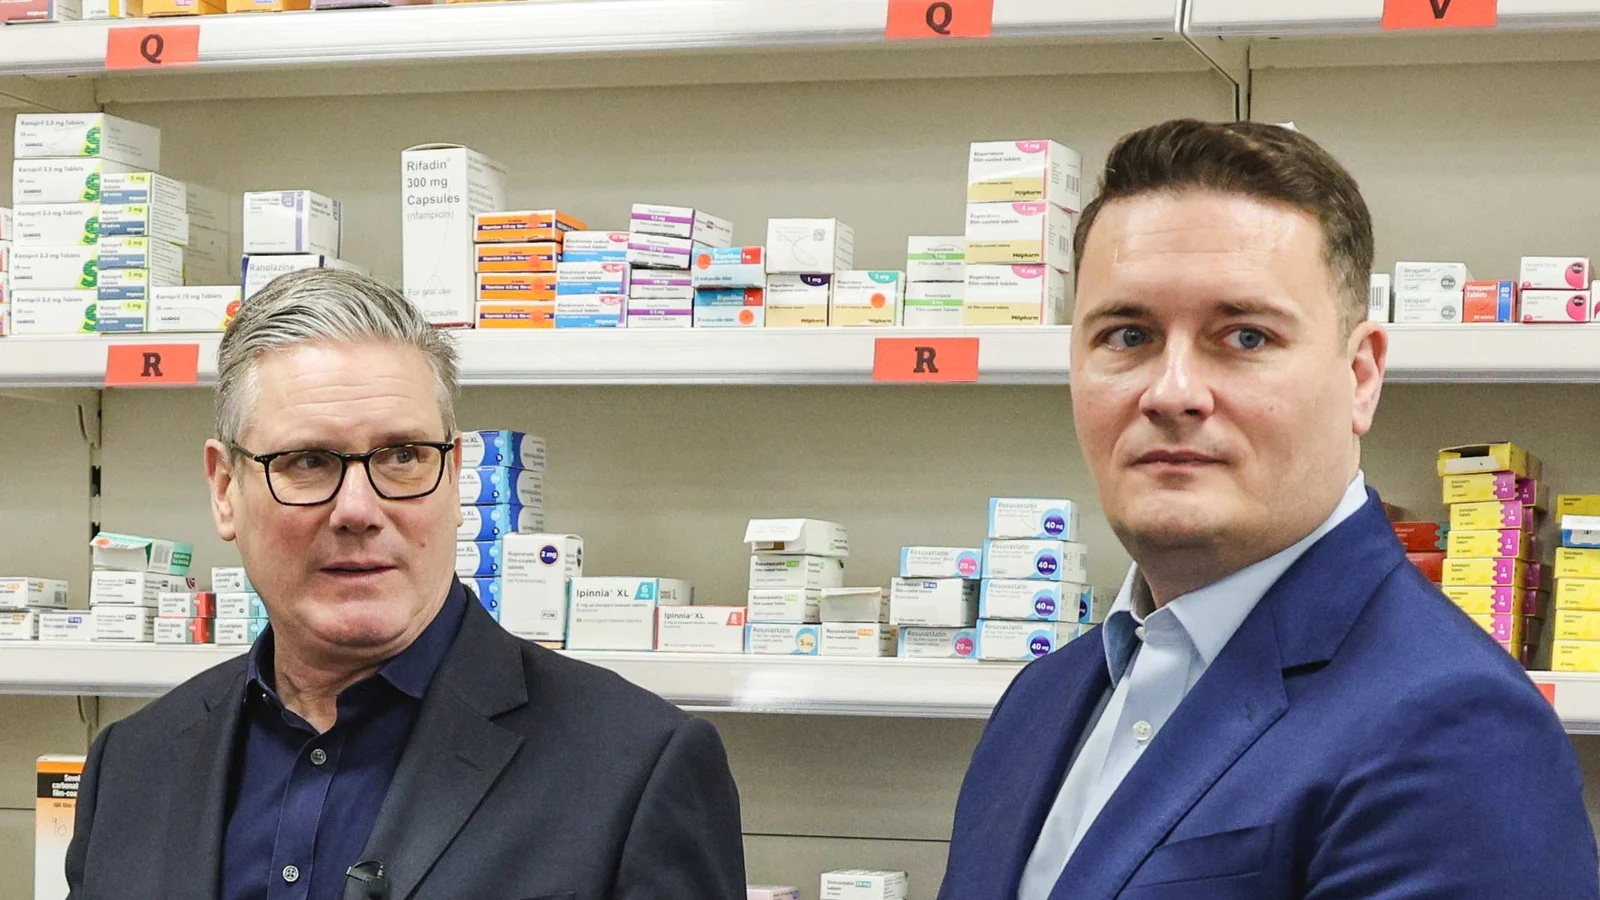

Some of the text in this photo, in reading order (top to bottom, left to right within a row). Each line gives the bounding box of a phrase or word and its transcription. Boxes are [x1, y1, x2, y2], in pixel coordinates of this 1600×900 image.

[926, 2, 952, 34] Q
[140, 34, 164, 64] Q
[406, 160, 447, 171] Rifadin
[406, 177, 448, 189] 300 mg
[407, 193, 461, 207] Capsules
[406, 209, 455, 221] (rifampicin)
[249, 263, 295, 271] Ranolazine
[407, 288, 420, 296] For
[423, 308, 459, 318] Capsules
[141, 353, 163, 377] R
[913, 347, 938, 373] R
[1045, 521, 1055, 529] 40
[959, 562, 968, 570] 20
[576, 588, 630, 598] Ipinnia XL
[664, 612, 691, 620] Ipinnia
[907, 630, 947, 638] Rosuvastatin
[955, 642, 965, 650] 20
